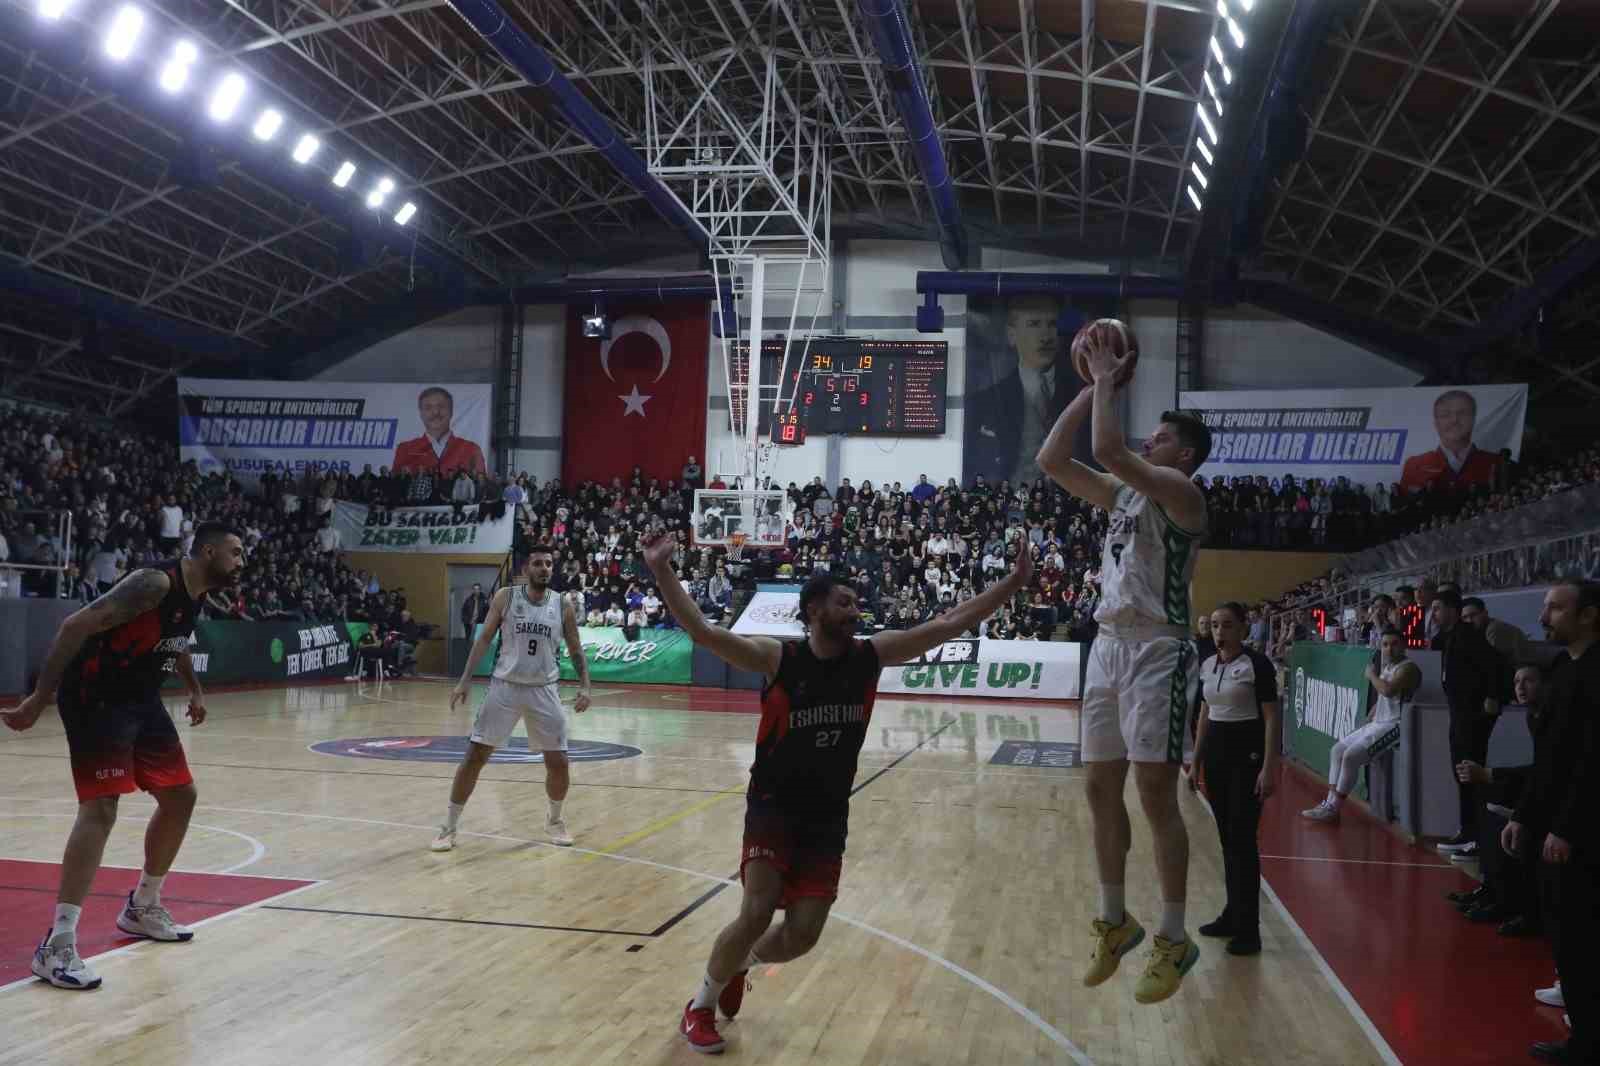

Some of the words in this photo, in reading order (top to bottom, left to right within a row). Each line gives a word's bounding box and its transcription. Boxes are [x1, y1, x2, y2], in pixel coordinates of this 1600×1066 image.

[813, 355, 831, 369] 34
[858, 355, 872, 369] 19
[268, 400, 283, 414] VE
[832, 393, 840, 405] 2
[1223, 412, 1266, 428] SPORCU
[1267, 412, 1281, 427] VE
[365, 511, 393, 526] BU
[396, 510, 482, 527] SAHADA
[360, 529, 418, 545] ZAFER
[429, 526, 477, 545] VAR!
[515, 622, 552, 640] SAKARYA
[528, 640, 538, 656] 9
[593, 640, 657, 662] RIVER
[902, 662, 980, 688] GIVE
[986, 662, 1042, 690] UP!
[815, 730, 842, 748] 27
